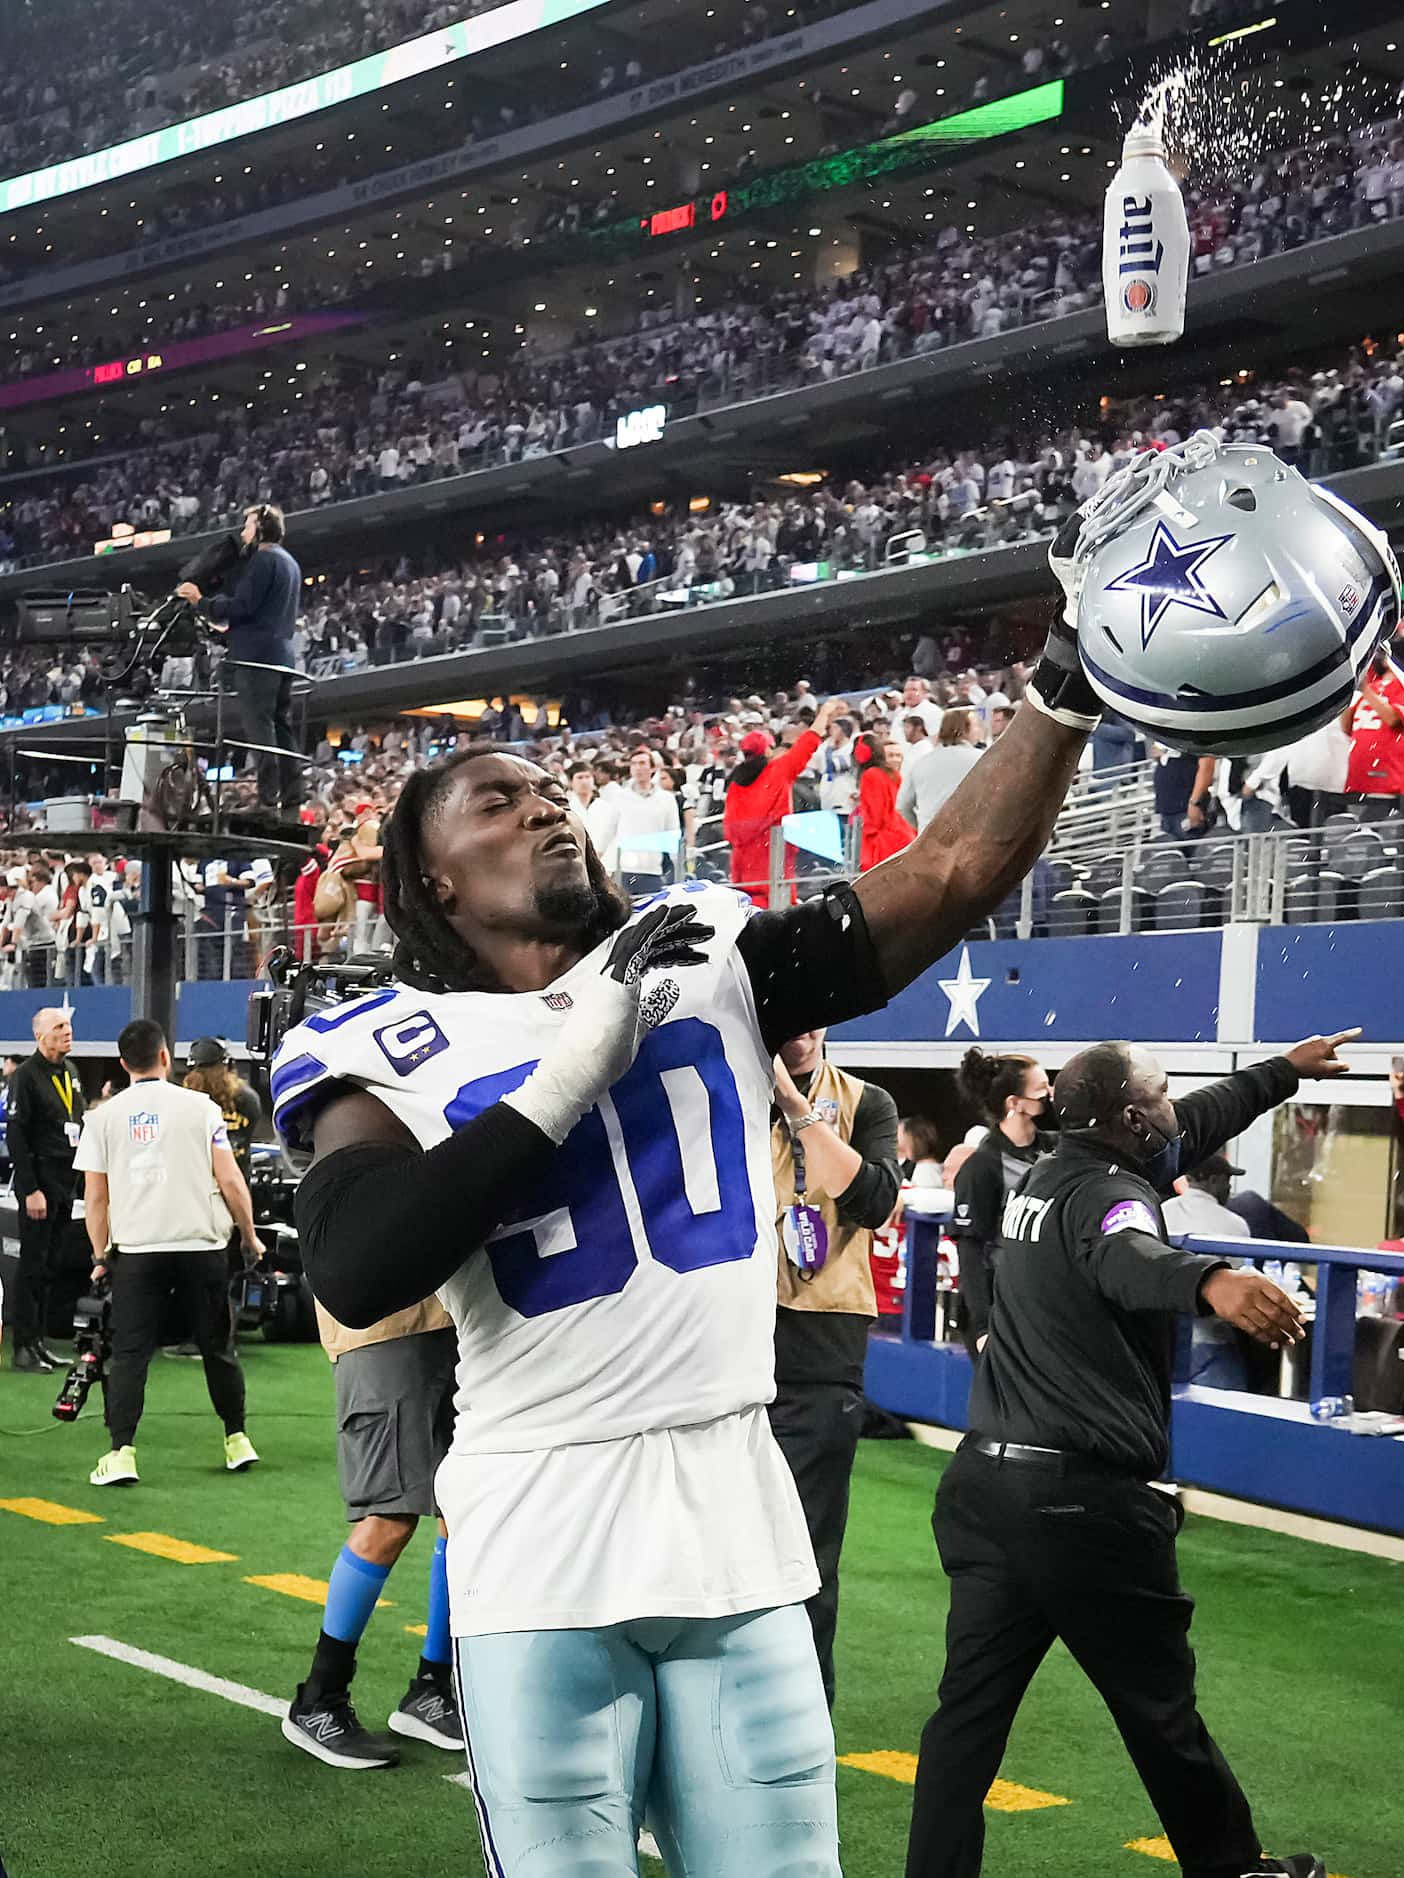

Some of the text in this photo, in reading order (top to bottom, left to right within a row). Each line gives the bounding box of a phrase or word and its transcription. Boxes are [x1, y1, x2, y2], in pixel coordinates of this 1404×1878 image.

[1119, 196, 1164, 280] Lite
[381, 1015, 437, 1059] C
[132, 1125, 158, 1142] NFL
[443, 1016, 759, 1319] 90
[803, 1235, 816, 1262] CARD
